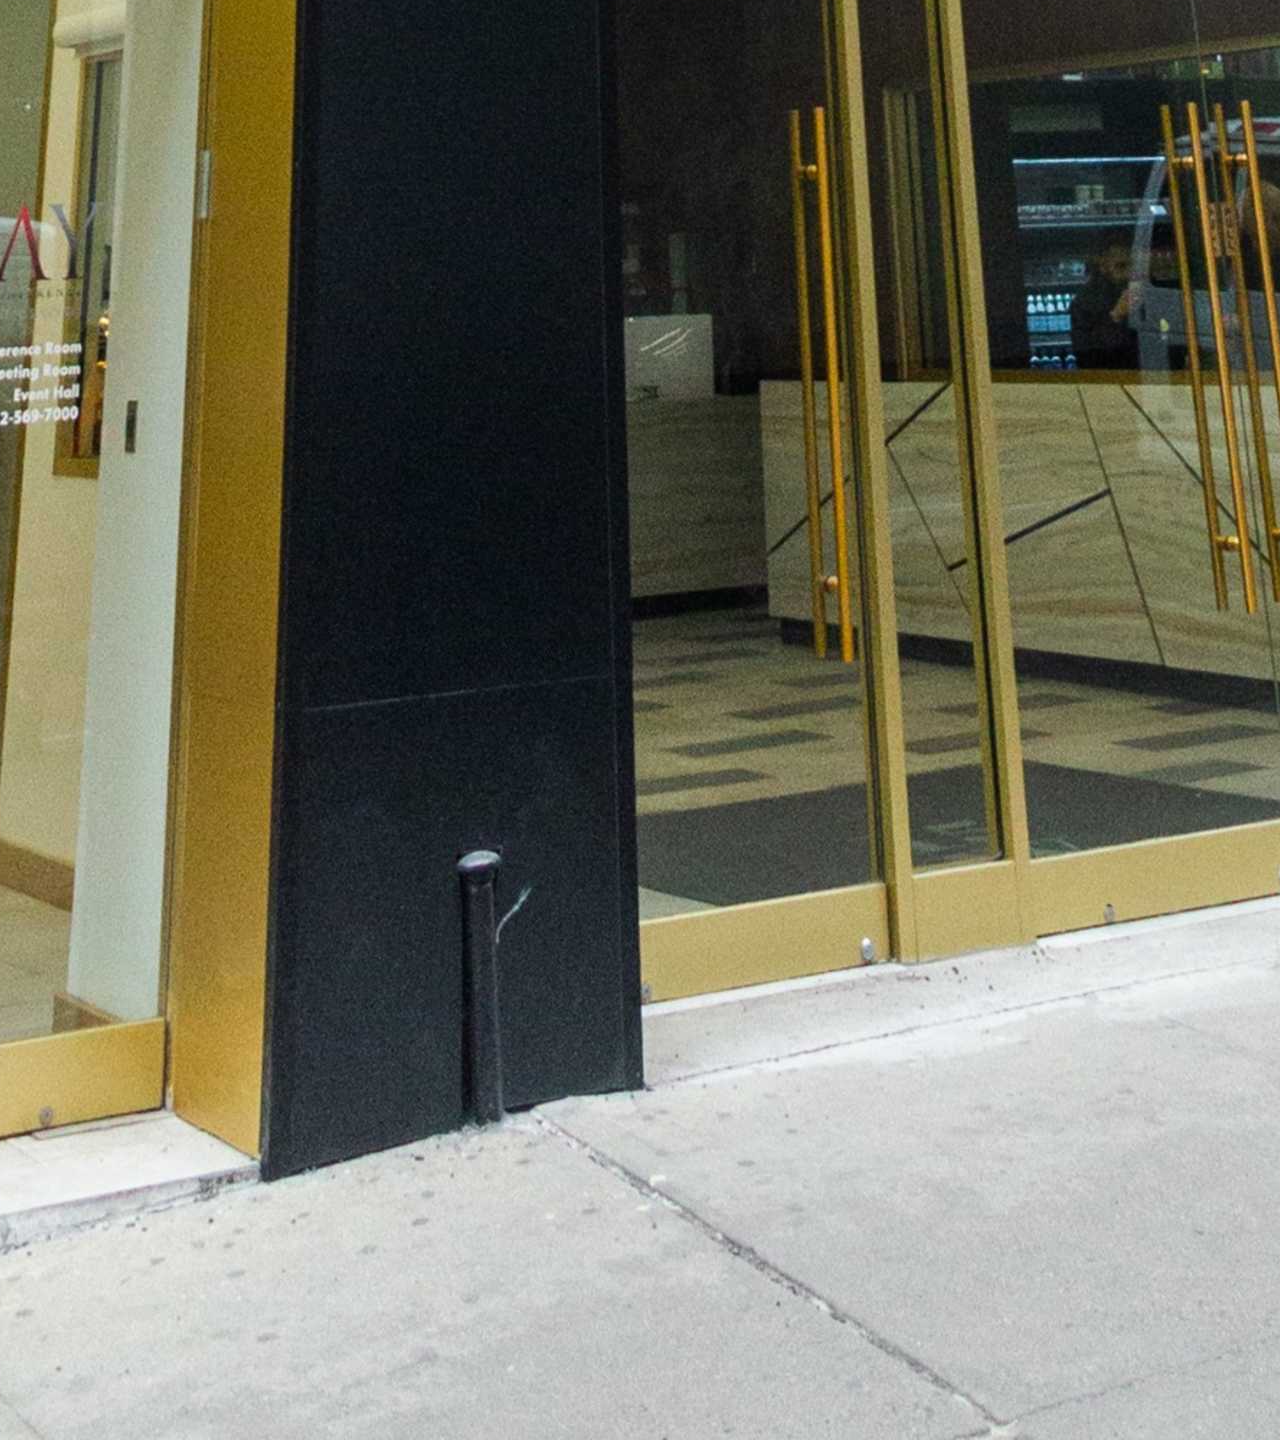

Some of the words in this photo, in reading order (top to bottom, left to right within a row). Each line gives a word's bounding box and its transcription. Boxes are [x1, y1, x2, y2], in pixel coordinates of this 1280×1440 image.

[45, 341, 82, 355] Room
[43, 364, 81, 377] Room
[13, 387, 49, 403] Event
[53, 383, 80, 399] Hall
